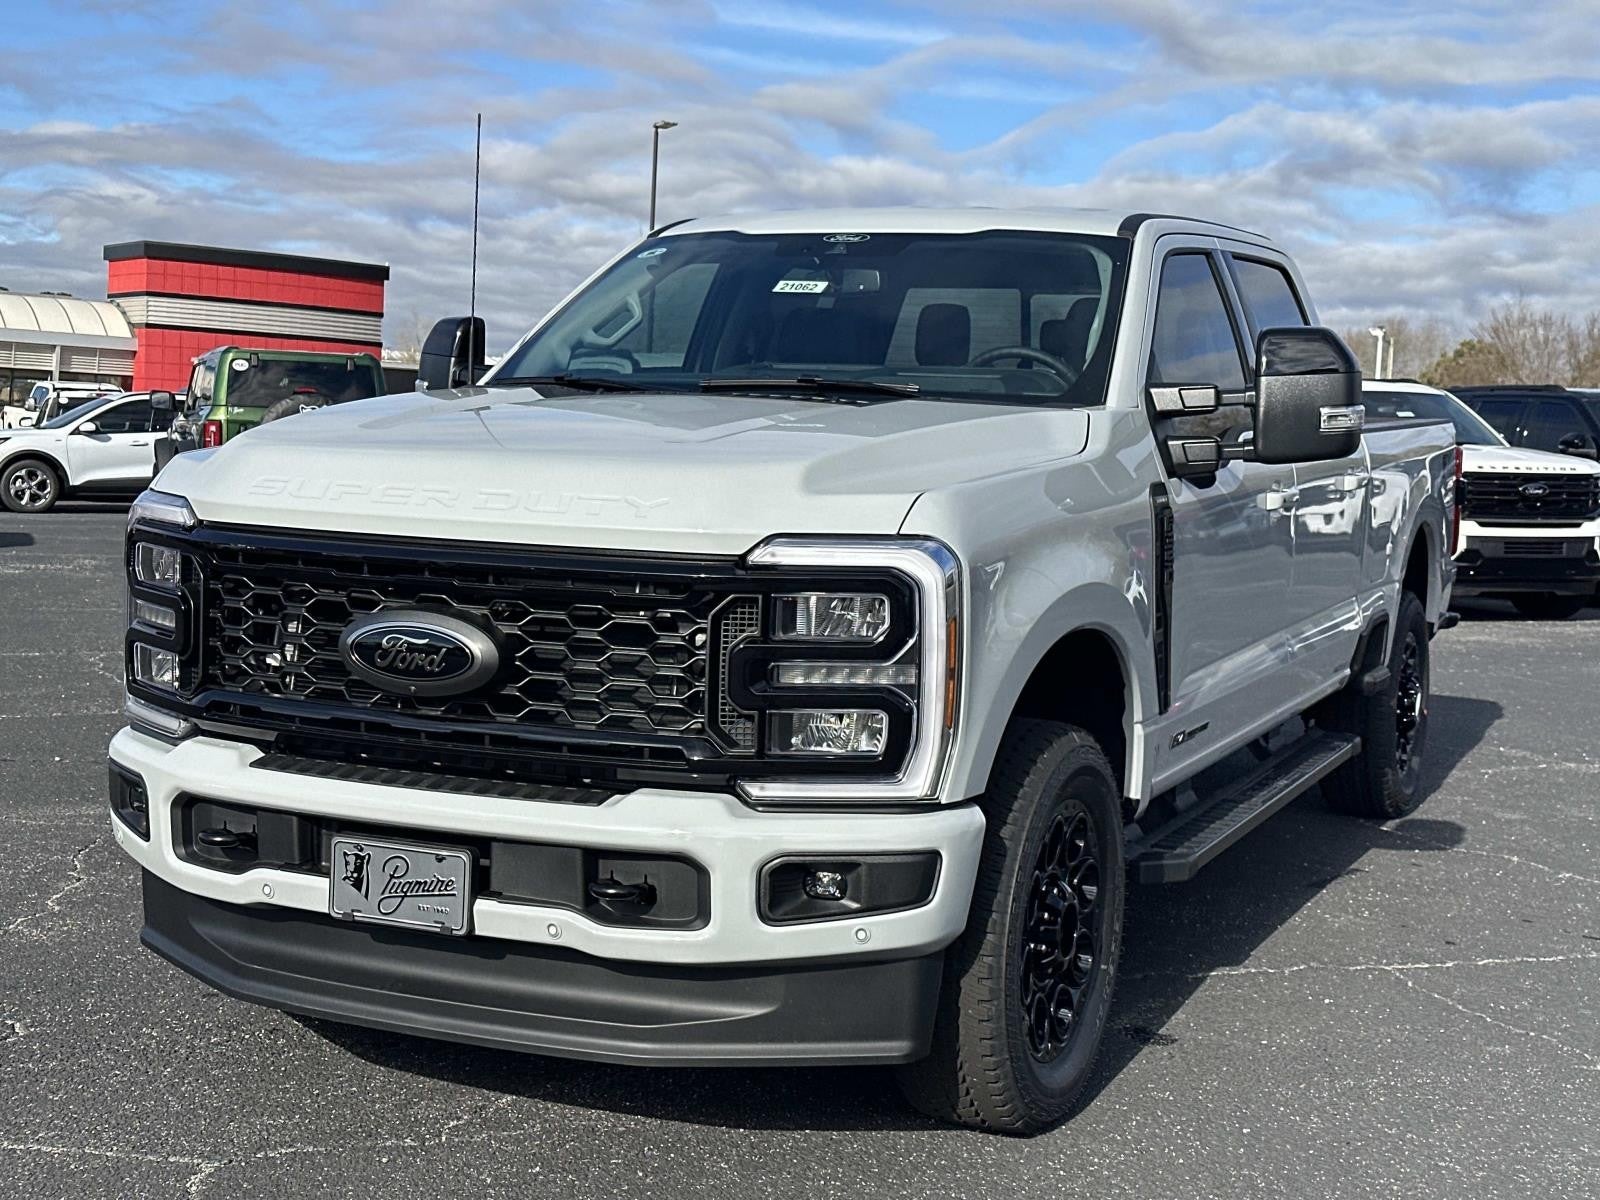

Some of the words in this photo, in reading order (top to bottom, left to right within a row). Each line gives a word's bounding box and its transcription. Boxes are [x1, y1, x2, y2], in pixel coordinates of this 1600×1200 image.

[829, 234, 864, 242] Ford
[780, 282, 818, 292] 21062
[246, 476, 461, 508] SUPER
[472, 488, 671, 519] DUTY
[374, 633, 448, 673] Ford
[378, 854, 457, 915] Pugmire
